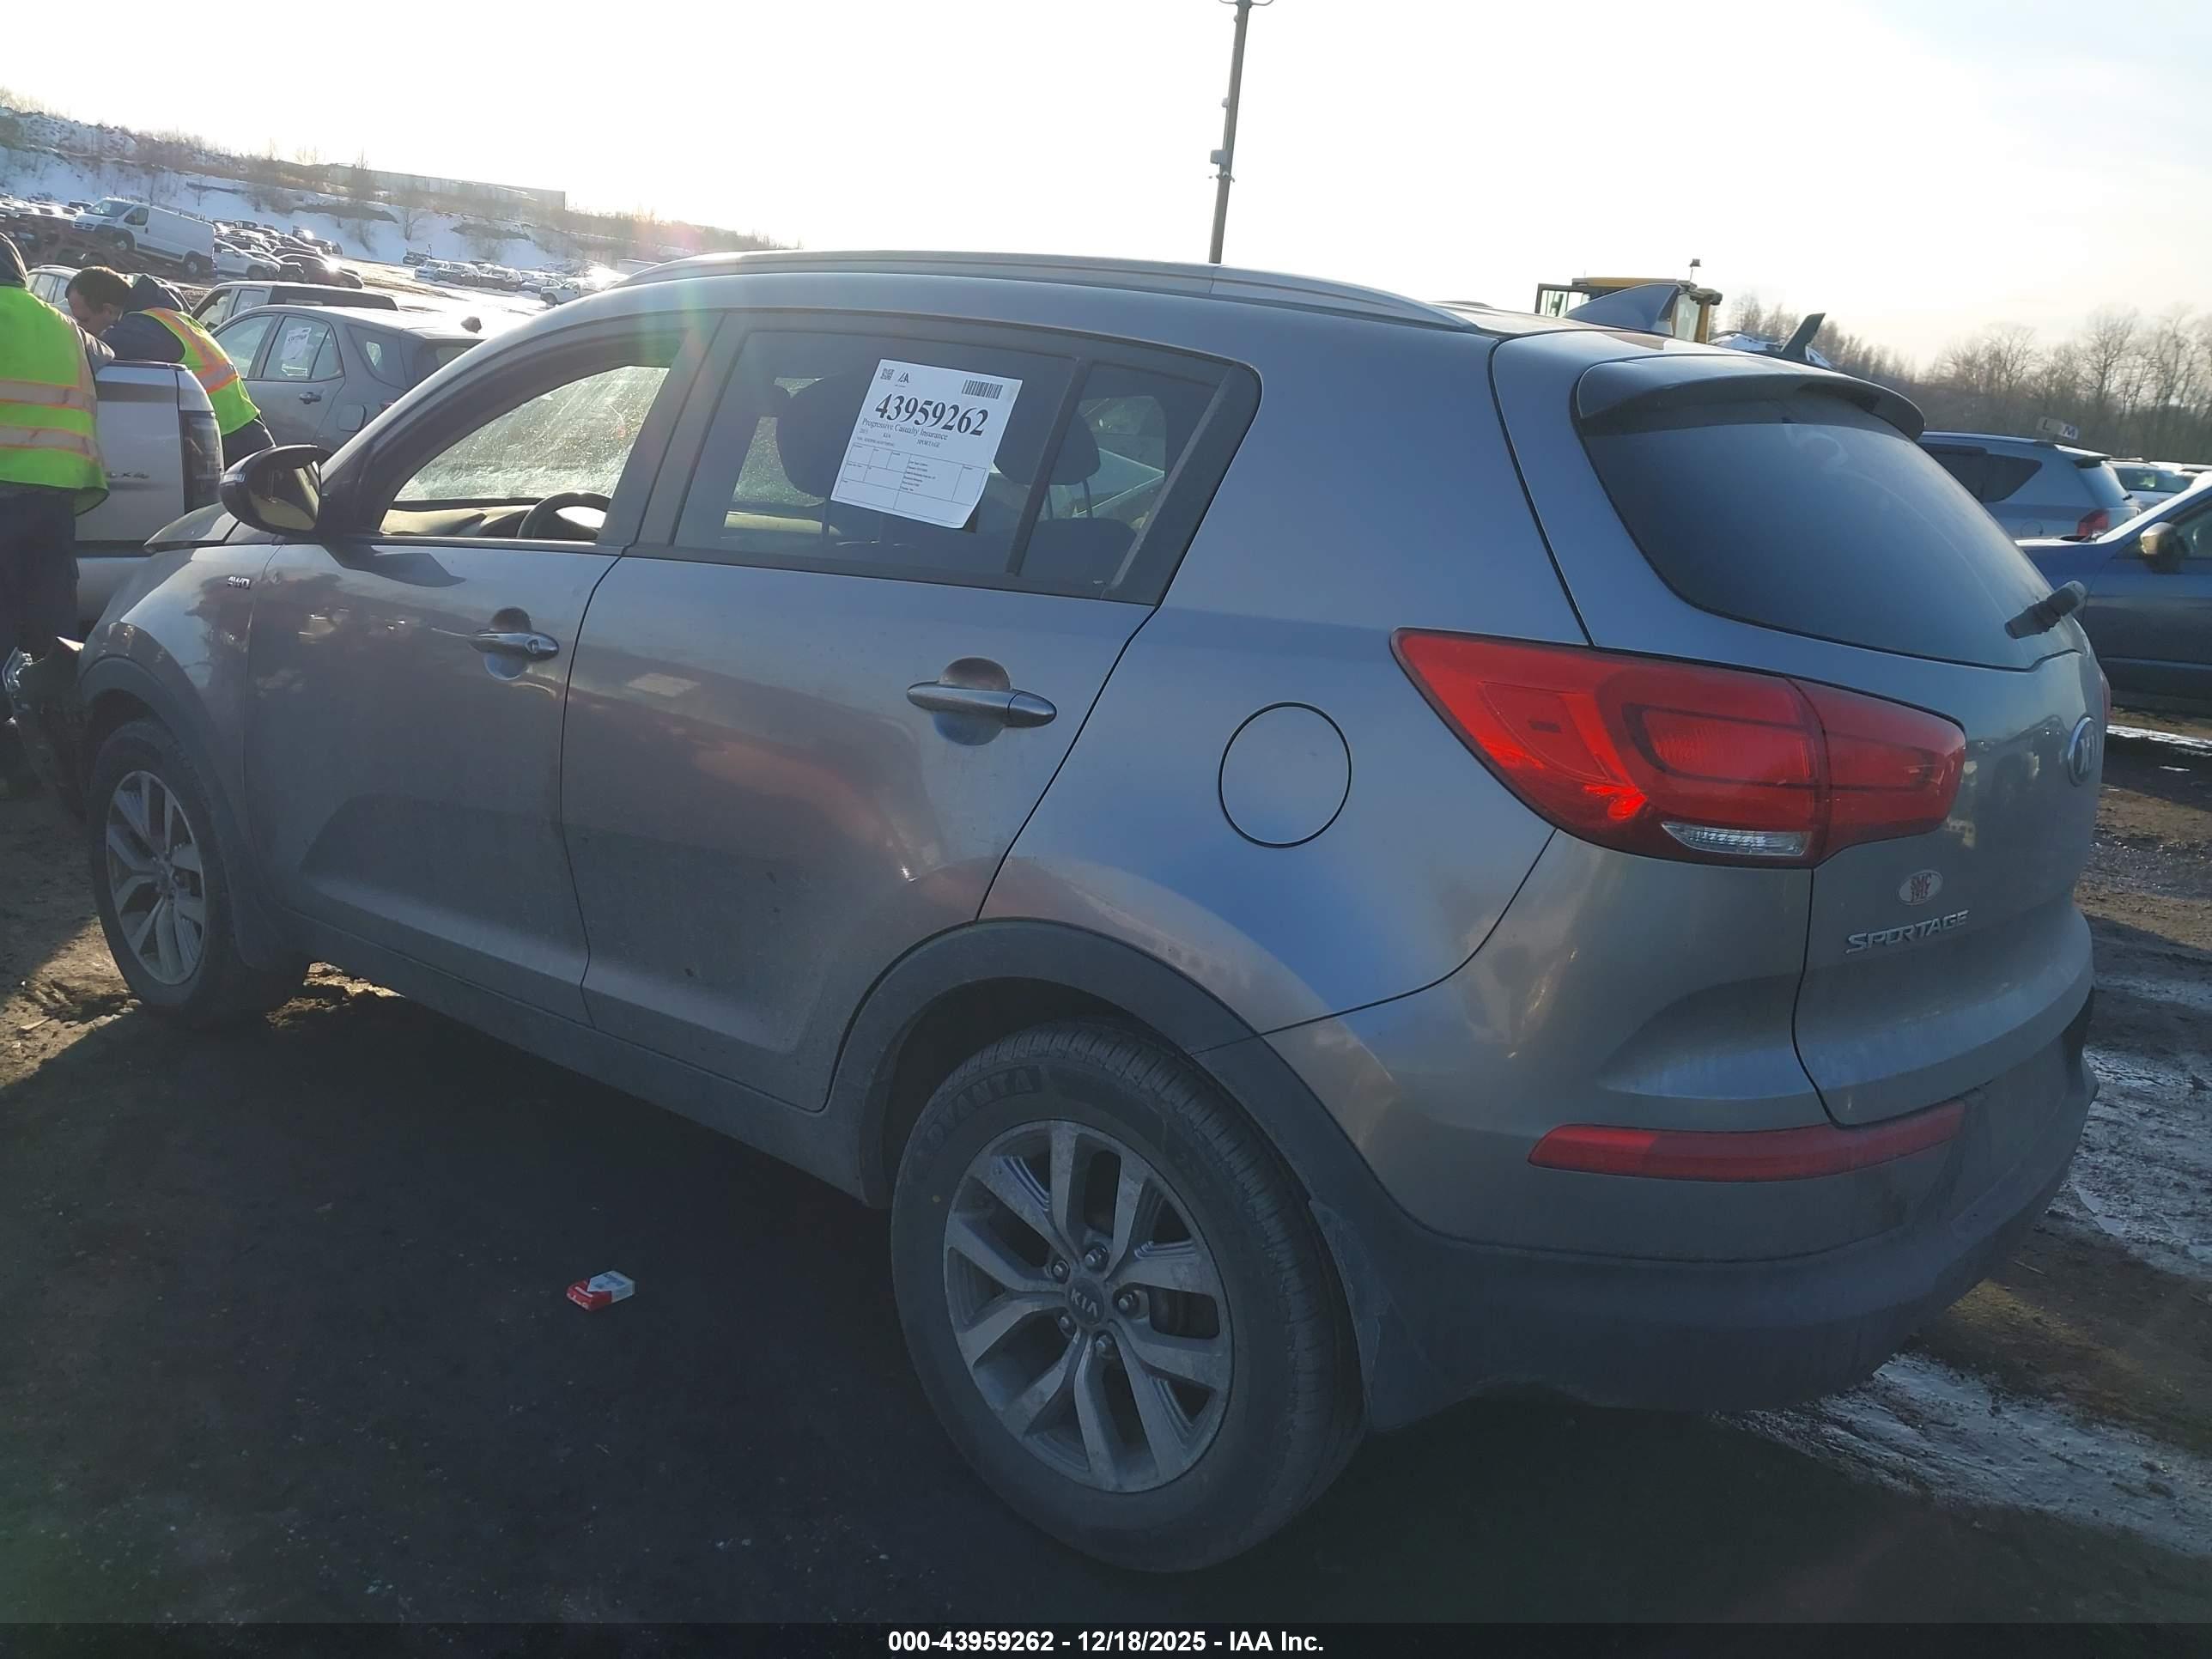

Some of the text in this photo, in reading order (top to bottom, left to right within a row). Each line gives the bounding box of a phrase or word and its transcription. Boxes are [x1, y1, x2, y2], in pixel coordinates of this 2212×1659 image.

[862, 418, 948, 441] Progressive Casualty Insurance
[875, 393, 988, 436] 43959262
[1845, 909, 1970, 954] SPORTAGE
